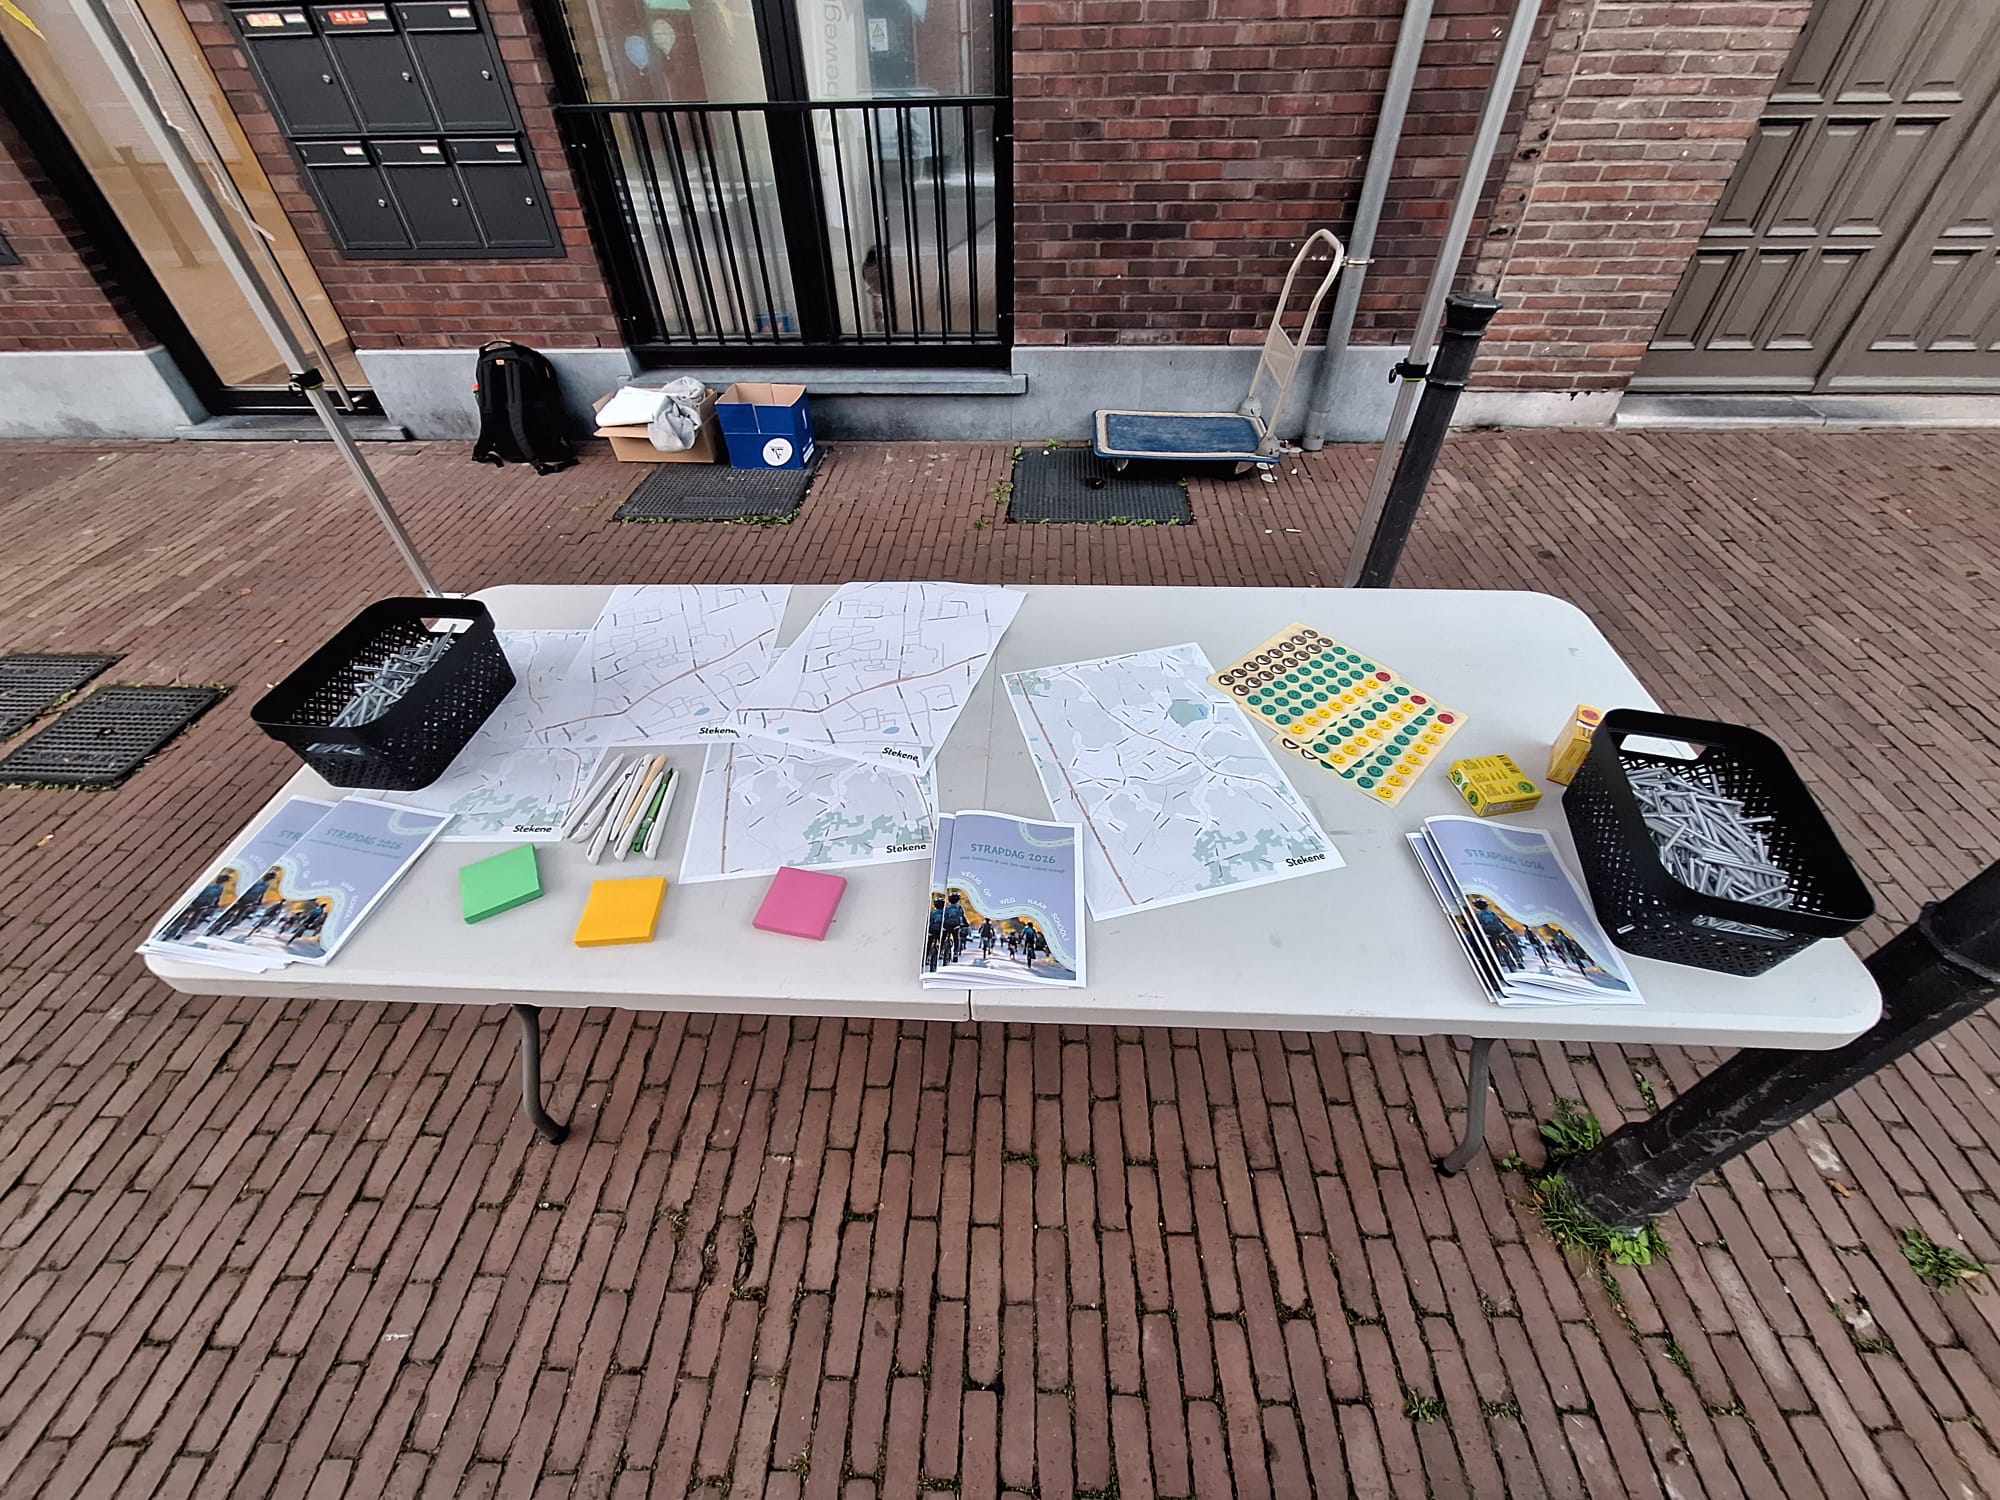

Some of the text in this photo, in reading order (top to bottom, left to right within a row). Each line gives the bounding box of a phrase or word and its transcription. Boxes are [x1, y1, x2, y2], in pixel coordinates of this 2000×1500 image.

[823, 0, 842, 97] beweg
[881, 747, 919, 761] Stekene
[513, 824, 552, 833] Stekene
[886, 843, 927, 854] Stekene
[970, 843, 1056, 864] STRAPDAG 2026
[1286, 853, 1326, 867] Stekene
[961, 871, 982, 885] VEILIG
[984, 888, 992, 898] OP
[999, 897, 1016, 905] WEG
[1027, 898, 1049, 911] NAAR
